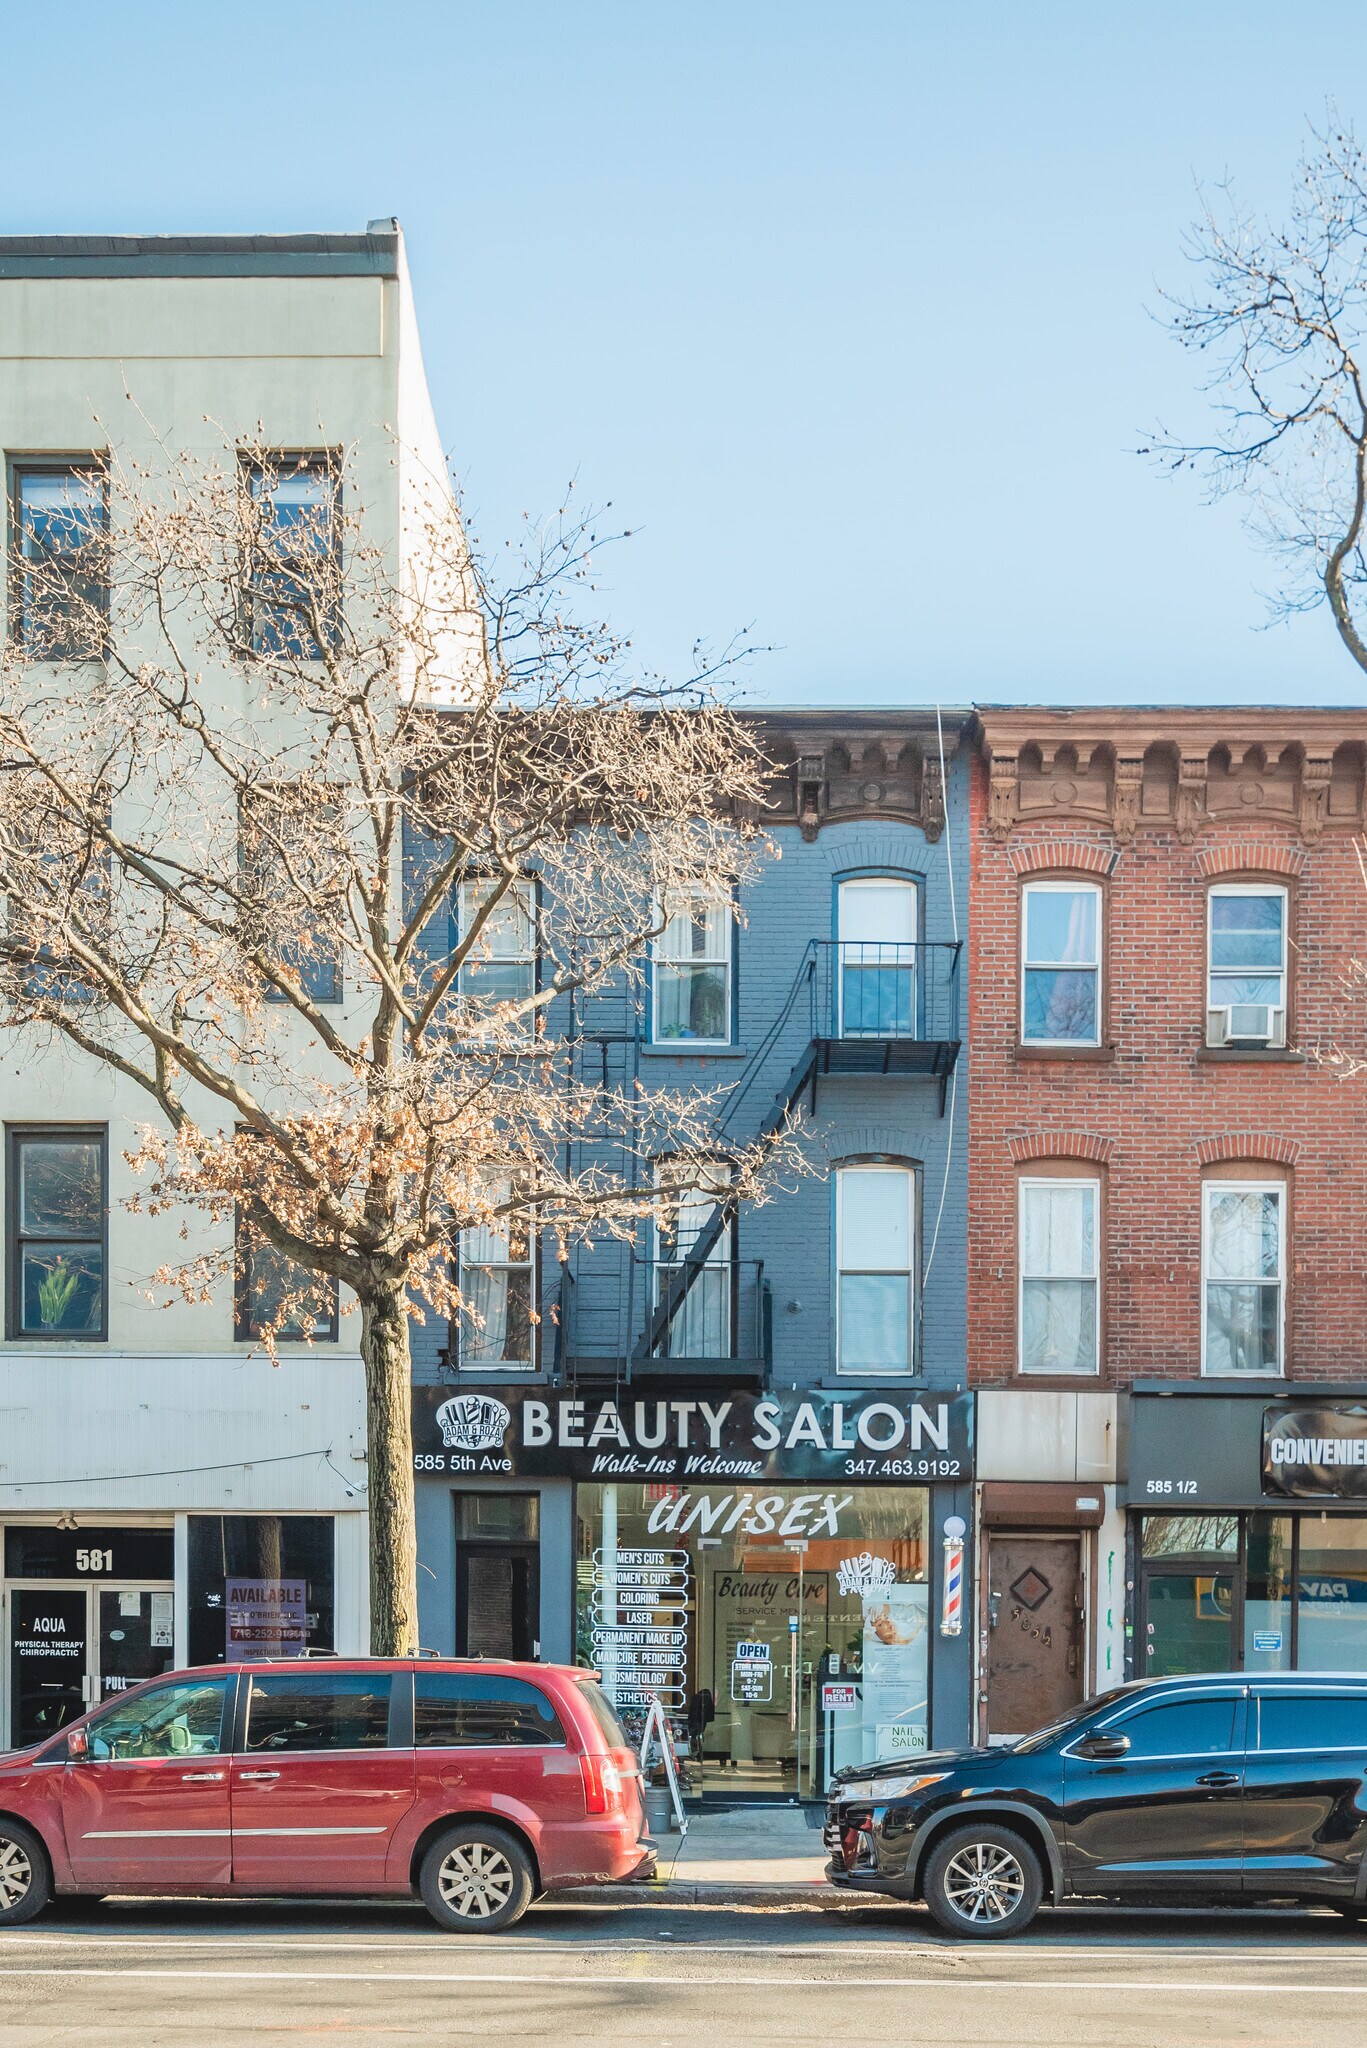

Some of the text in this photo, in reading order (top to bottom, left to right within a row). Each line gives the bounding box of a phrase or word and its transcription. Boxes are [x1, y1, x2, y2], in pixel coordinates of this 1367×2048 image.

[446, 1424, 500, 1437] ADAM & ROZA
[522, 1401, 949, 1452] BEAUTY SALON
[1271, 1438, 1367, 1465] CONVENIE
[414, 1454, 512, 1471] 585 5th Ave
[591, 1454, 763, 1475] Walk-Ins Welcome
[844, 1459, 961, 1476] 347.463.9192
[1146, 1480, 1198, 1494] 585 1/2
[647, 1493, 853, 1537] UNISEX
[76, 1549, 113, 1571] 581
[616, 1552, 665, 1564] MEN'S CUTS
[610, 1572, 671, 1585] WOMEN'S CUTS
[231, 1587, 302, 1603] AVAILABLE
[718, 1576, 779, 1605] Beauty
[619, 1592, 660, 1604] COLORING
[626, 1612, 653, 1624] LASER
[736, 1607, 777, 1616] SERVICE
[33, 1617, 66, 1633] AQUA
[14, 1640, 50, 1648] PHYSICAL
[595, 1631, 683, 1645] PERMANENT MAKE UP
[20, 1648, 79, 1656] CHIROPRACTIC
[596, 1651, 681, 1665] MANICURE PEDICURE
[739, 1644, 767, 1658] OPEN
[105, 1676, 127, 1690] PULL
[609, 1672, 667, 1684] COSMETOLOGY
[612, 1692, 658, 1703] ESTHETICS
[825, 1693, 853, 1702] RENT
[892, 1727, 914, 1736] NAIL
[892, 1737, 925, 1747] SALON
